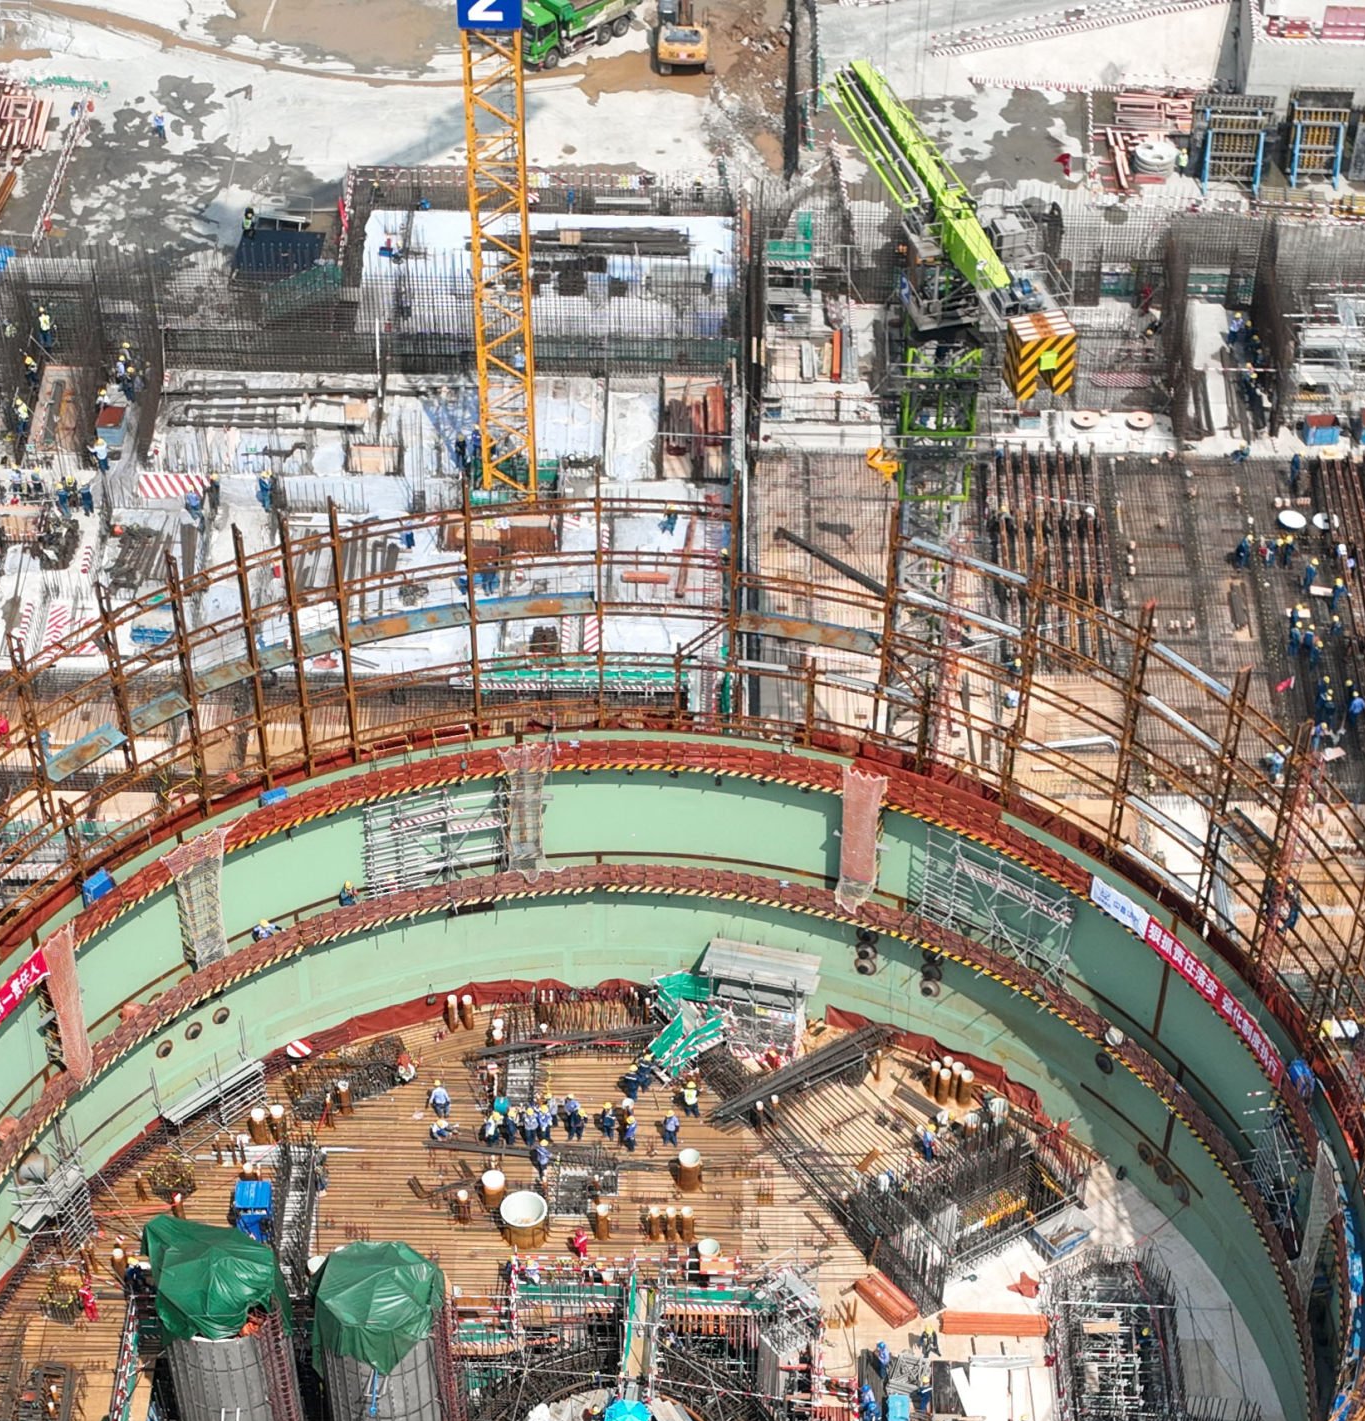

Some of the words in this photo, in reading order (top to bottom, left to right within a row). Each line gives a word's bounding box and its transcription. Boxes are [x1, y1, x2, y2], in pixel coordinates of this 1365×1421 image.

[1147, 923, 1218, 1000] 狠抓责任落实
